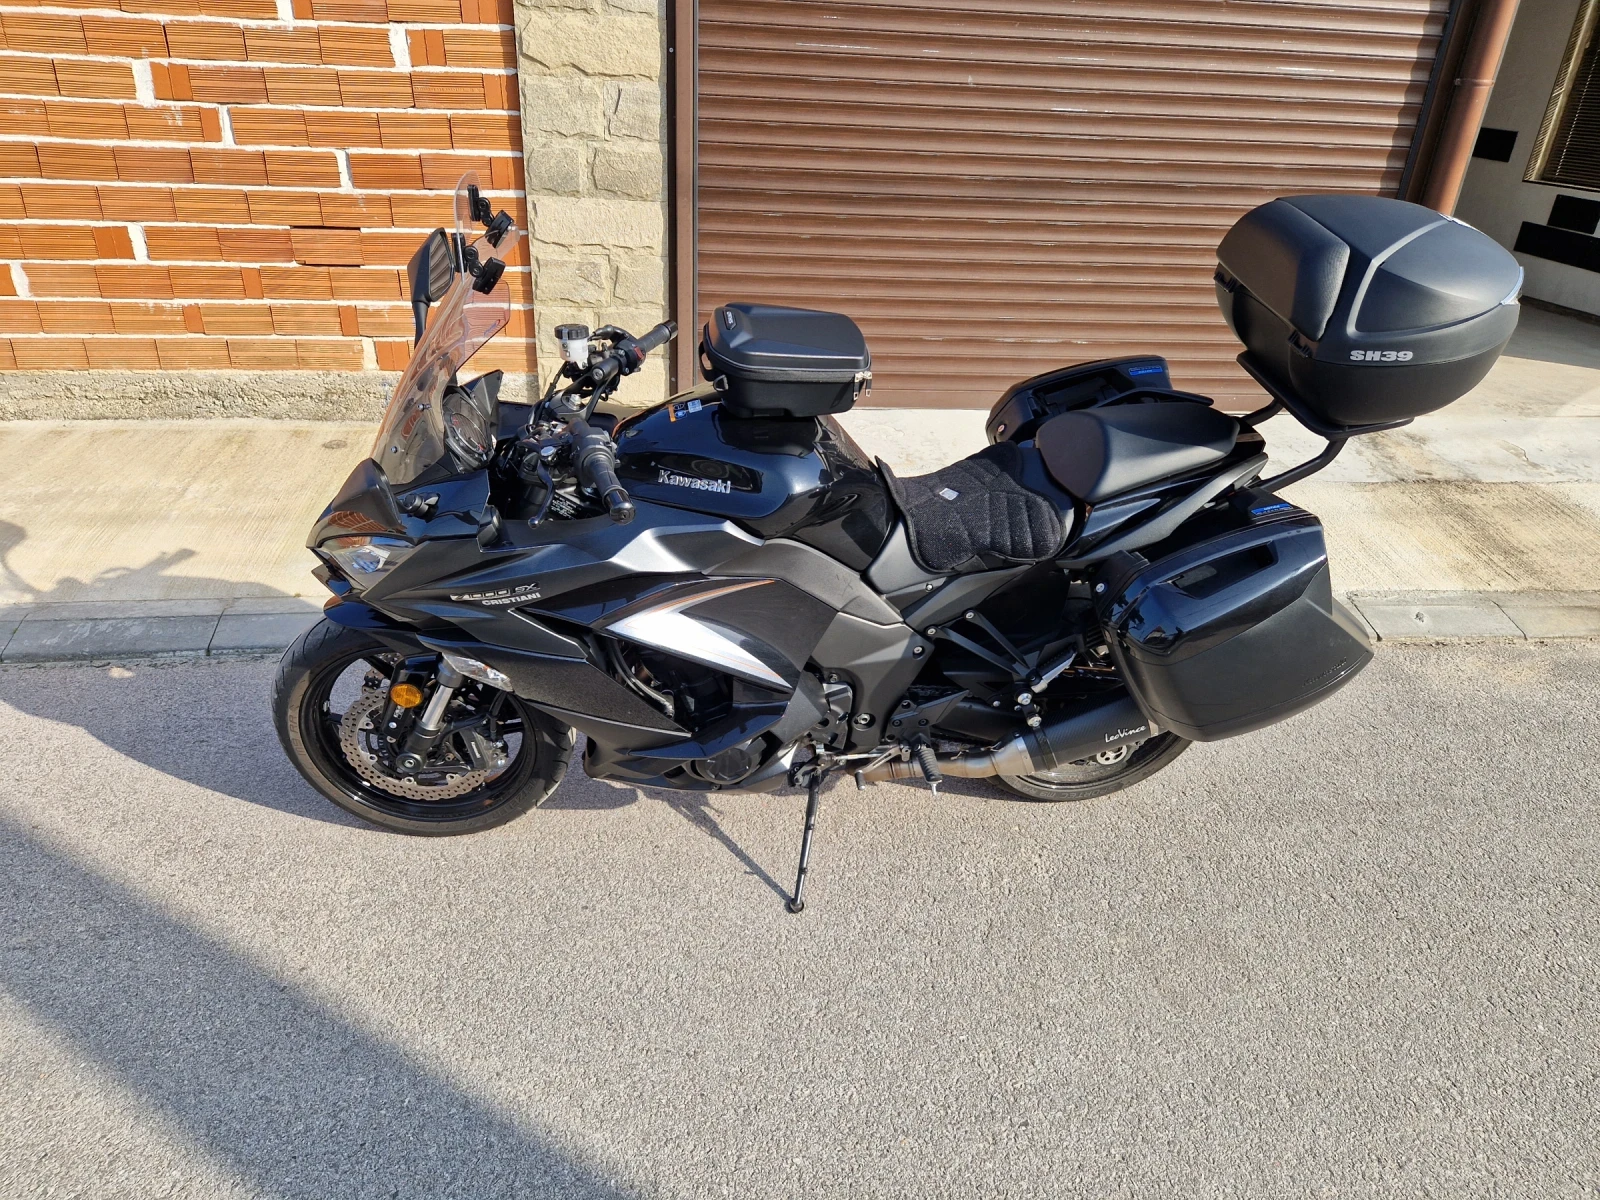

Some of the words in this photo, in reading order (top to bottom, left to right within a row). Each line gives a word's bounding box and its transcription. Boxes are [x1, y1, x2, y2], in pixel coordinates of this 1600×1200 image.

[1349, 350, 1414, 361] SH39
[657, 469, 731, 494] Kawasaki
[481, 592, 541, 606] CRISTIANI
[1105, 725, 1147, 743] LeoVince
